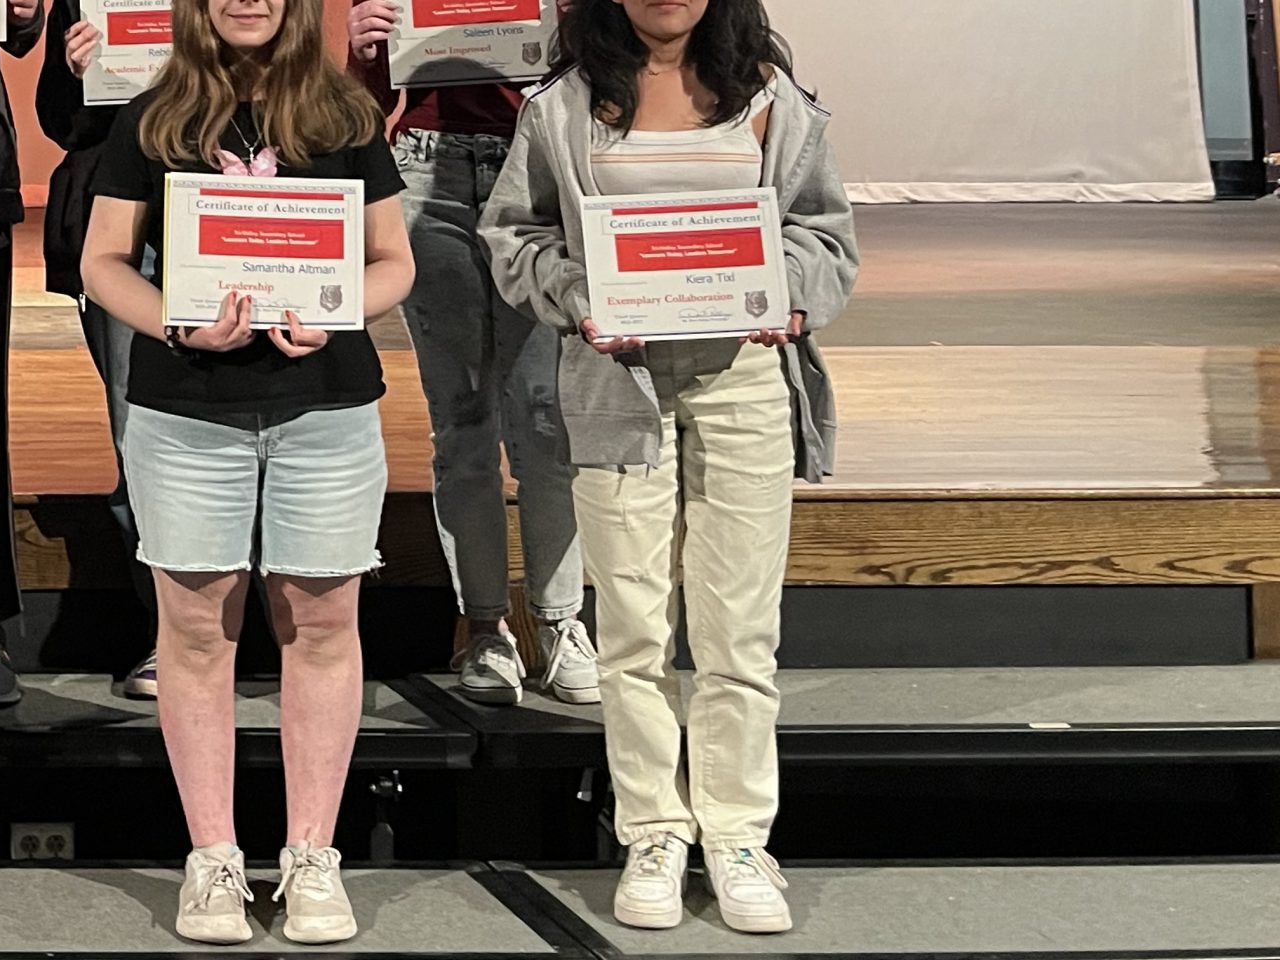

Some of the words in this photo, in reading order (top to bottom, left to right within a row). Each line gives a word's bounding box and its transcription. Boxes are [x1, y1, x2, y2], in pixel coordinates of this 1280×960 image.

[104, 0, 152, 8] Certificate
[497, 26, 523, 37] Lyons
[449, 45, 491, 55] Improved
[105, 66, 145, 74] Academic
[196, 200, 253, 211] Certificate
[274, 204, 345, 214] Achievement
[610, 219, 667, 229] Certificate
[690, 214, 760, 225] Achievement
[243, 262, 294, 274] Samantha
[299, 264, 335, 274] Altman
[686, 274, 712, 284] Kiera
[219, 280, 274, 294] Leadership
[608, 295, 661, 307] Exemplary
[665, 292, 734, 303] Collaboration
